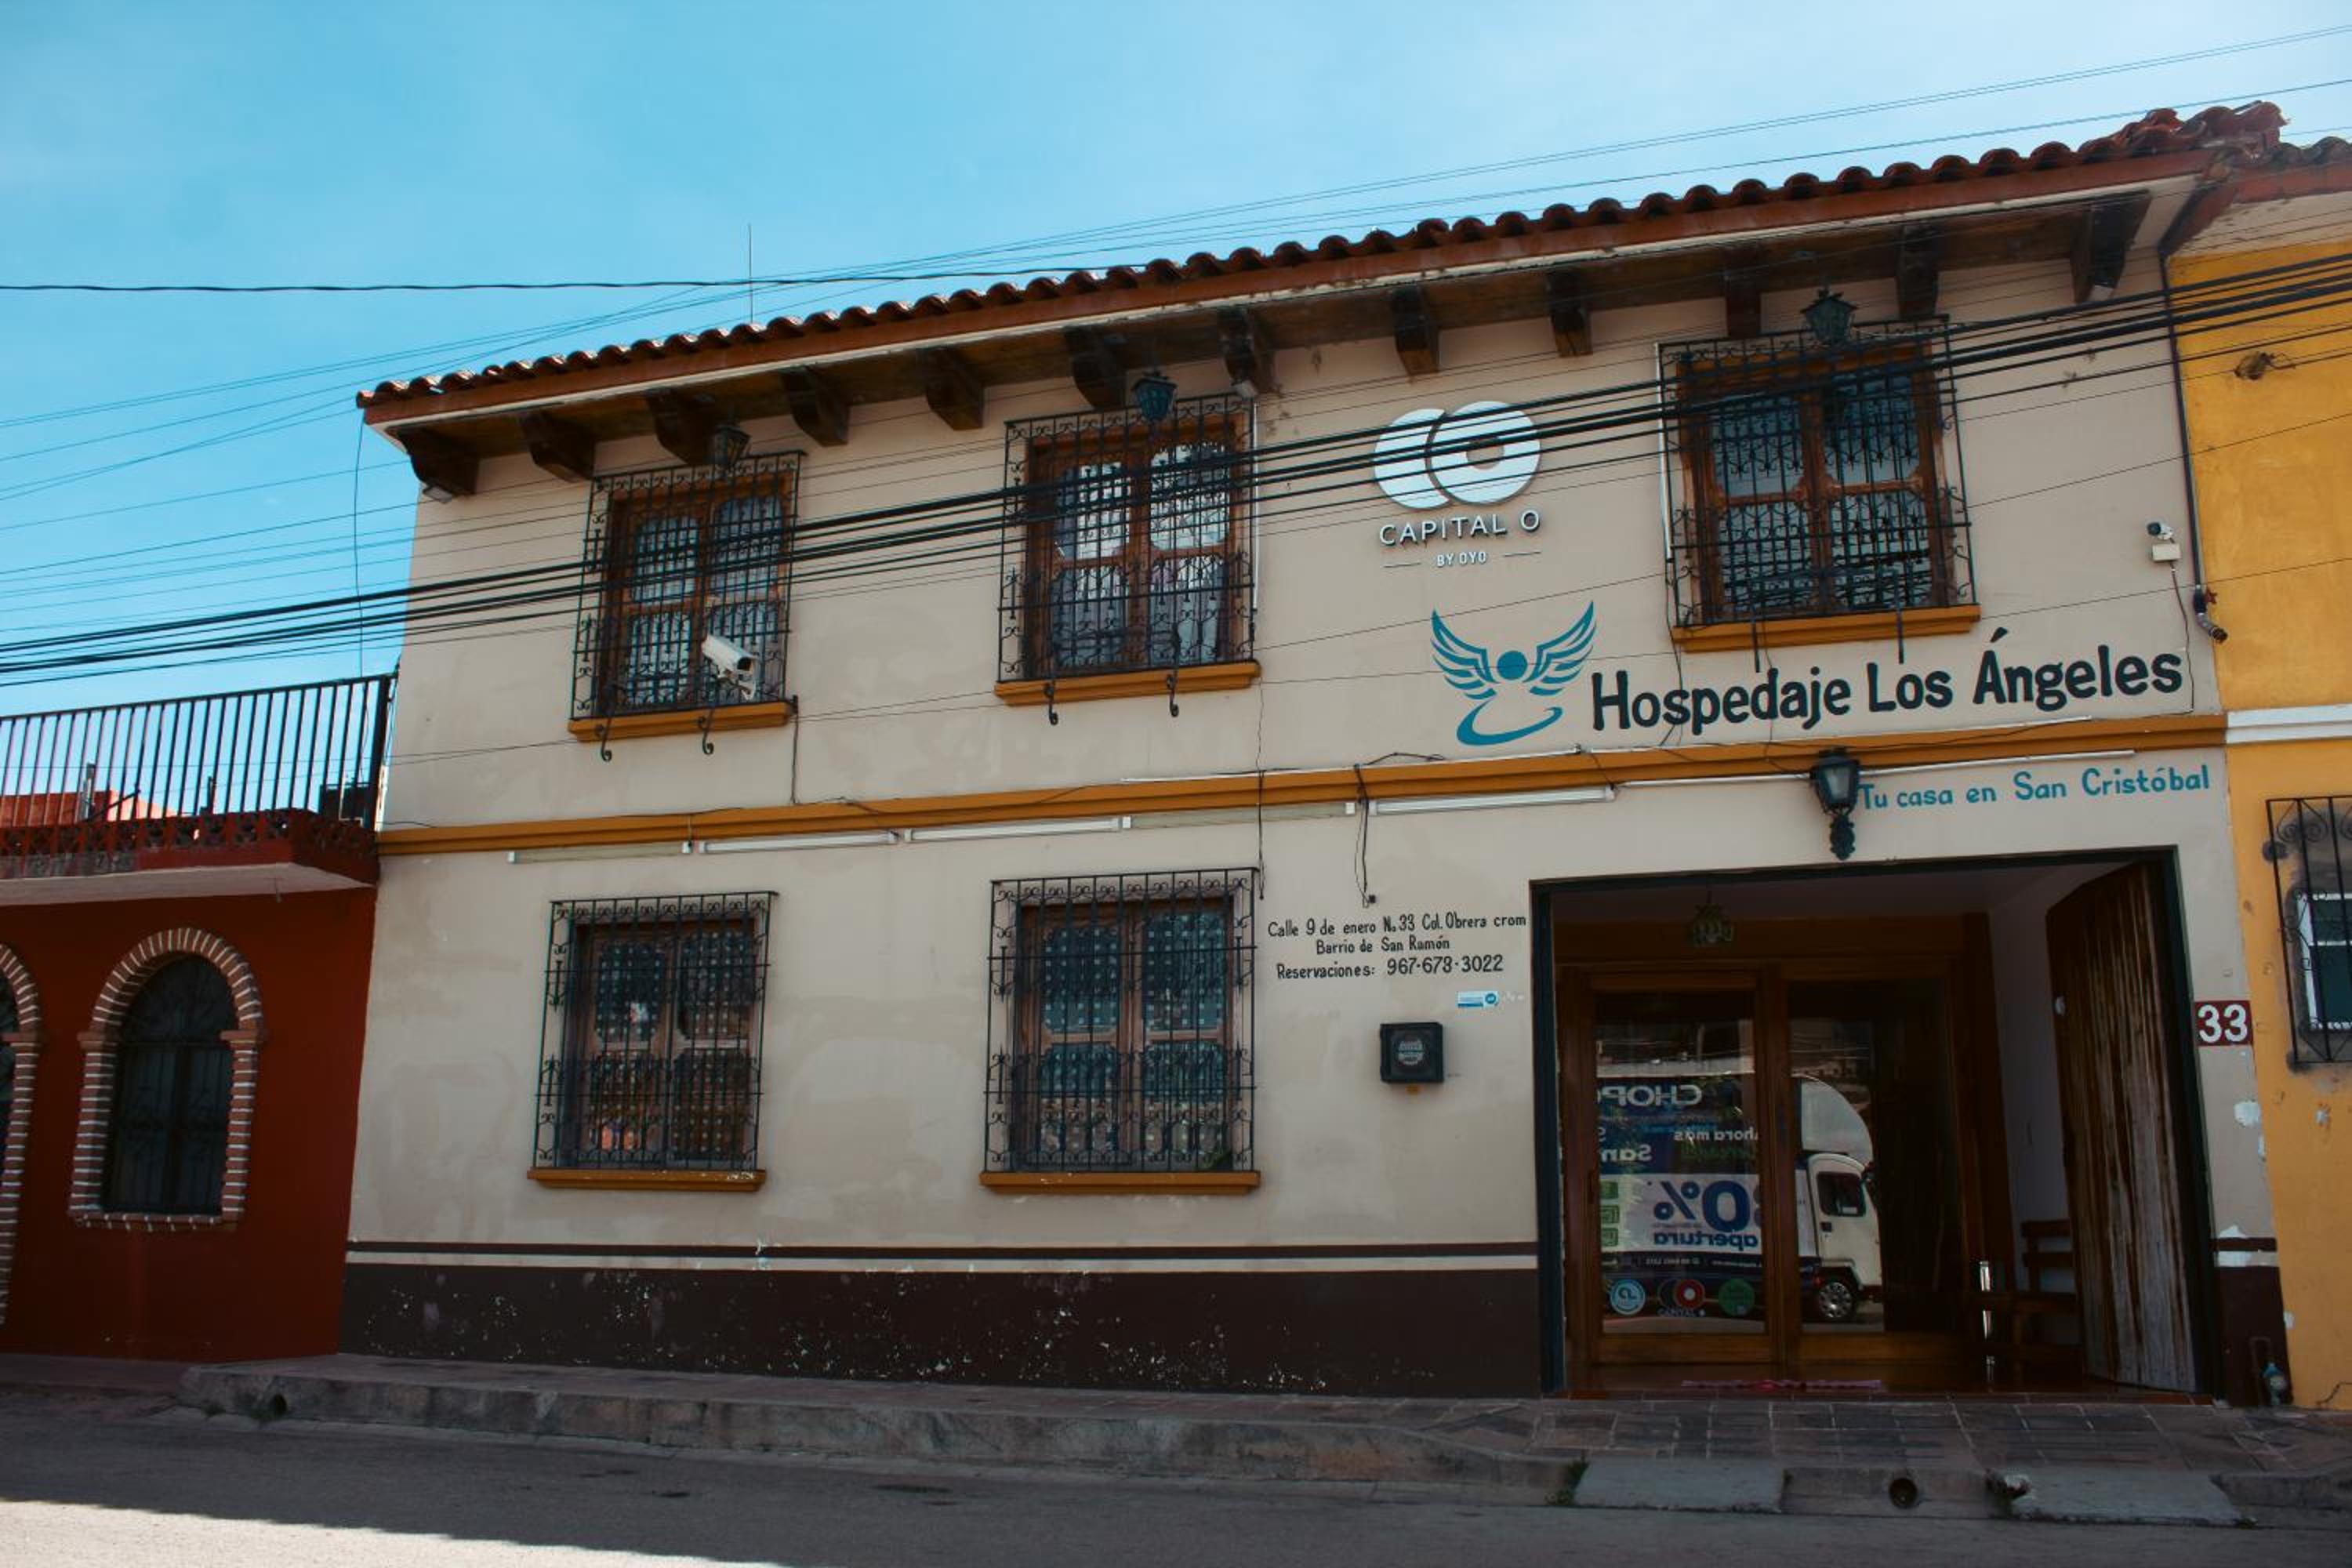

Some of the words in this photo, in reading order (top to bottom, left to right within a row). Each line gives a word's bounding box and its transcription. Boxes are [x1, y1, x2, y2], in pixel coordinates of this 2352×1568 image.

[1379, 514, 1507, 546] CAPITAL
[1520, 510, 1541, 532] O
[1437, 552, 1455, 568] BY
[1458, 550, 1487, 566] OYO
[1591, 666, 1852, 736] Hospedaje
[1866, 662, 1955, 713] Los
[1972, 626, 2183, 712] Ángeles
[1857, 783, 1888, 810] Tu
[1896, 789, 1953, 808] casa
[1965, 786, 1997, 804] en
[2013, 771, 2067, 800] San
[2082, 764, 2210, 797] Cristóbal
[1267, 919, 1299, 938] Calle
[1305, 918, 1316, 936] 9
[1319, 918, 1336, 935] de
[1343, 922, 1377, 935] enero
[1445, 909, 1488, 930] Obrera
[1316, 939, 1356, 956] Barrio
[1359, 938, 1374, 953] de
[1381, 935, 1405, 953] San
[1408, 934, 1450, 952] Ramón
[1276, 960, 1376, 981] Reservaciones:
[2197, 1003, 2249, 1044] 33
